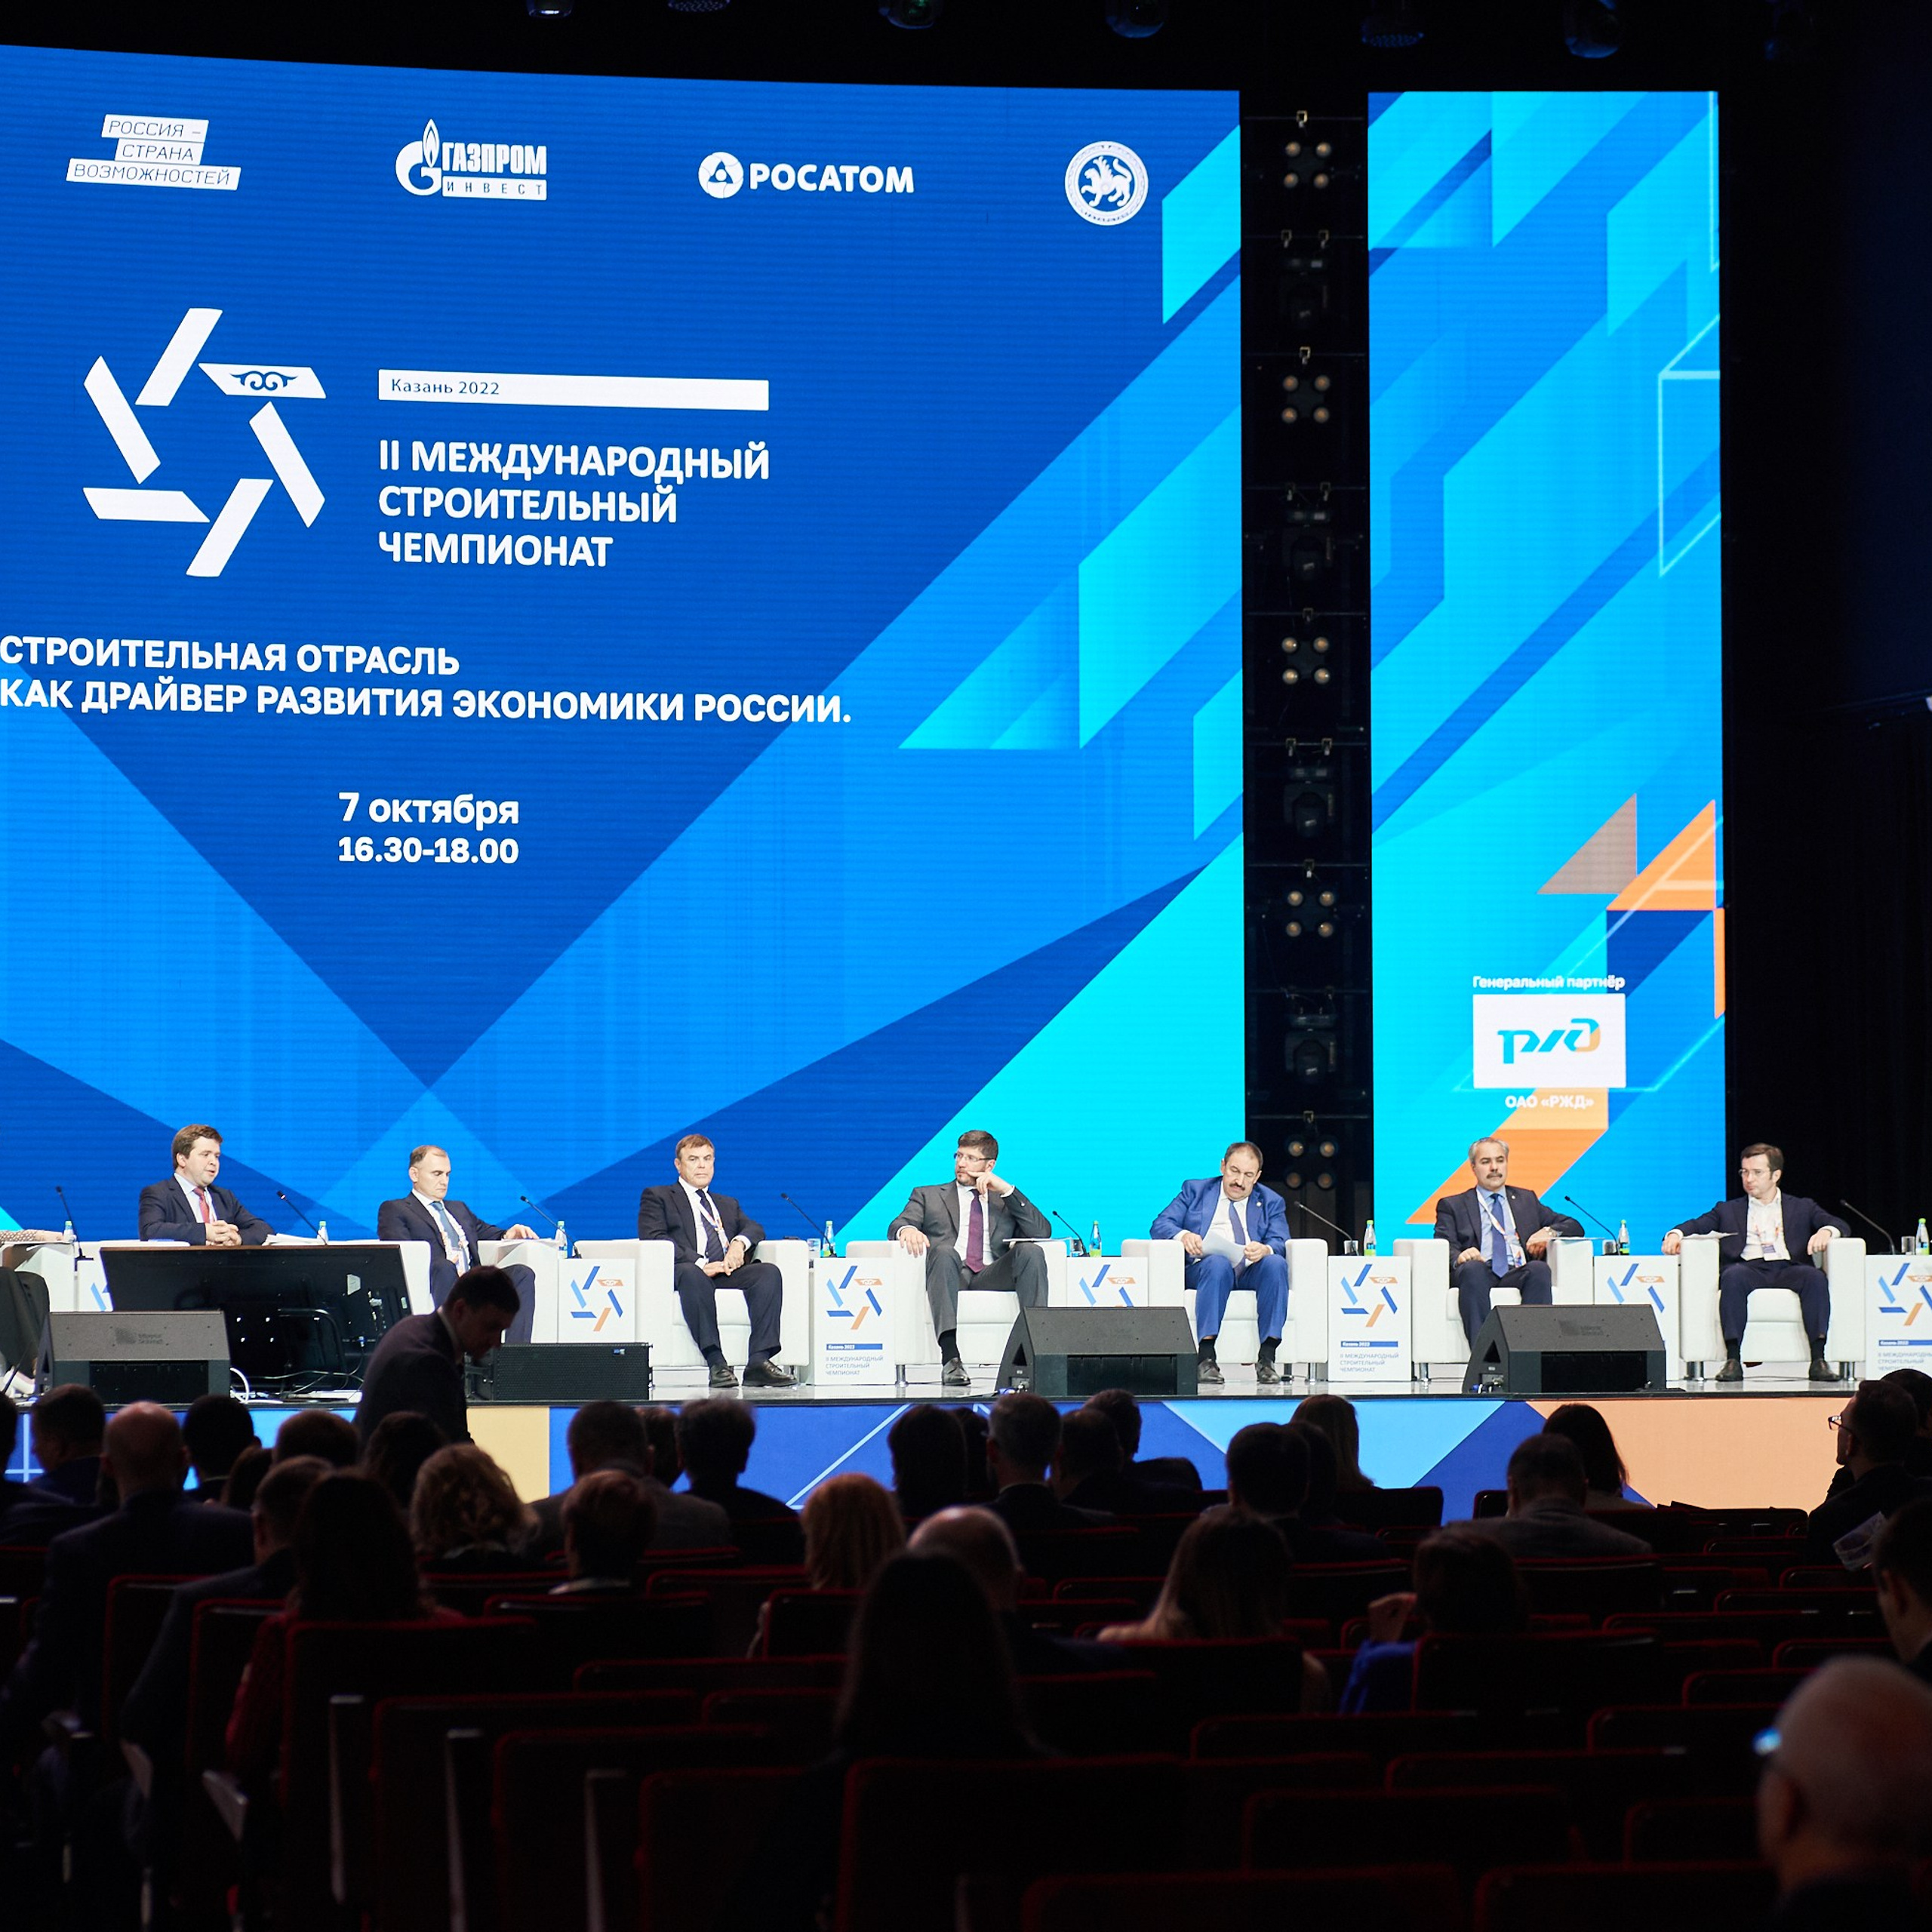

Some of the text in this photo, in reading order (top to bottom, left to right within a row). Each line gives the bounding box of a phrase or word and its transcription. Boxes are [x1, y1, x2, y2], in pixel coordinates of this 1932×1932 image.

[109, 120, 184, 137] РОССИЯ
[122, 143, 193, 162] СТРАНА
[442, 142, 547, 175] ГАЗПРОМ
[74, 164, 230, 185] ВОЗМОЖНОСТЕЙ
[447, 181, 543, 195] ИНВЕСТ
[750, 163, 914, 193] РОСАТОМ
[392, 378, 500, 395] Казань 2022
[411, 440, 769, 485] МЕЖДУНАРОДНЫЙ
[378, 485, 677, 523] СТРОИТЕЛЬНЫЙ
[378, 531, 614, 567] ЧЕМПИОНАТ
[0, 635, 460, 675] СТРОИТЕЛЬНАЯ ОТРАСЛЬ
[0, 675, 852, 723] КАК ДРАЙВЕР РАЗВИТИЯ ЭКОНОМИКИ РОССИИ.
[338, 792, 519, 830] 7 октября
[338, 835, 519, 864] 16.30-18.00
[1472, 975, 1626, 991] Генеральный партнёр
[1505, 1095, 1594, 1109] ОАО «РЖД»
